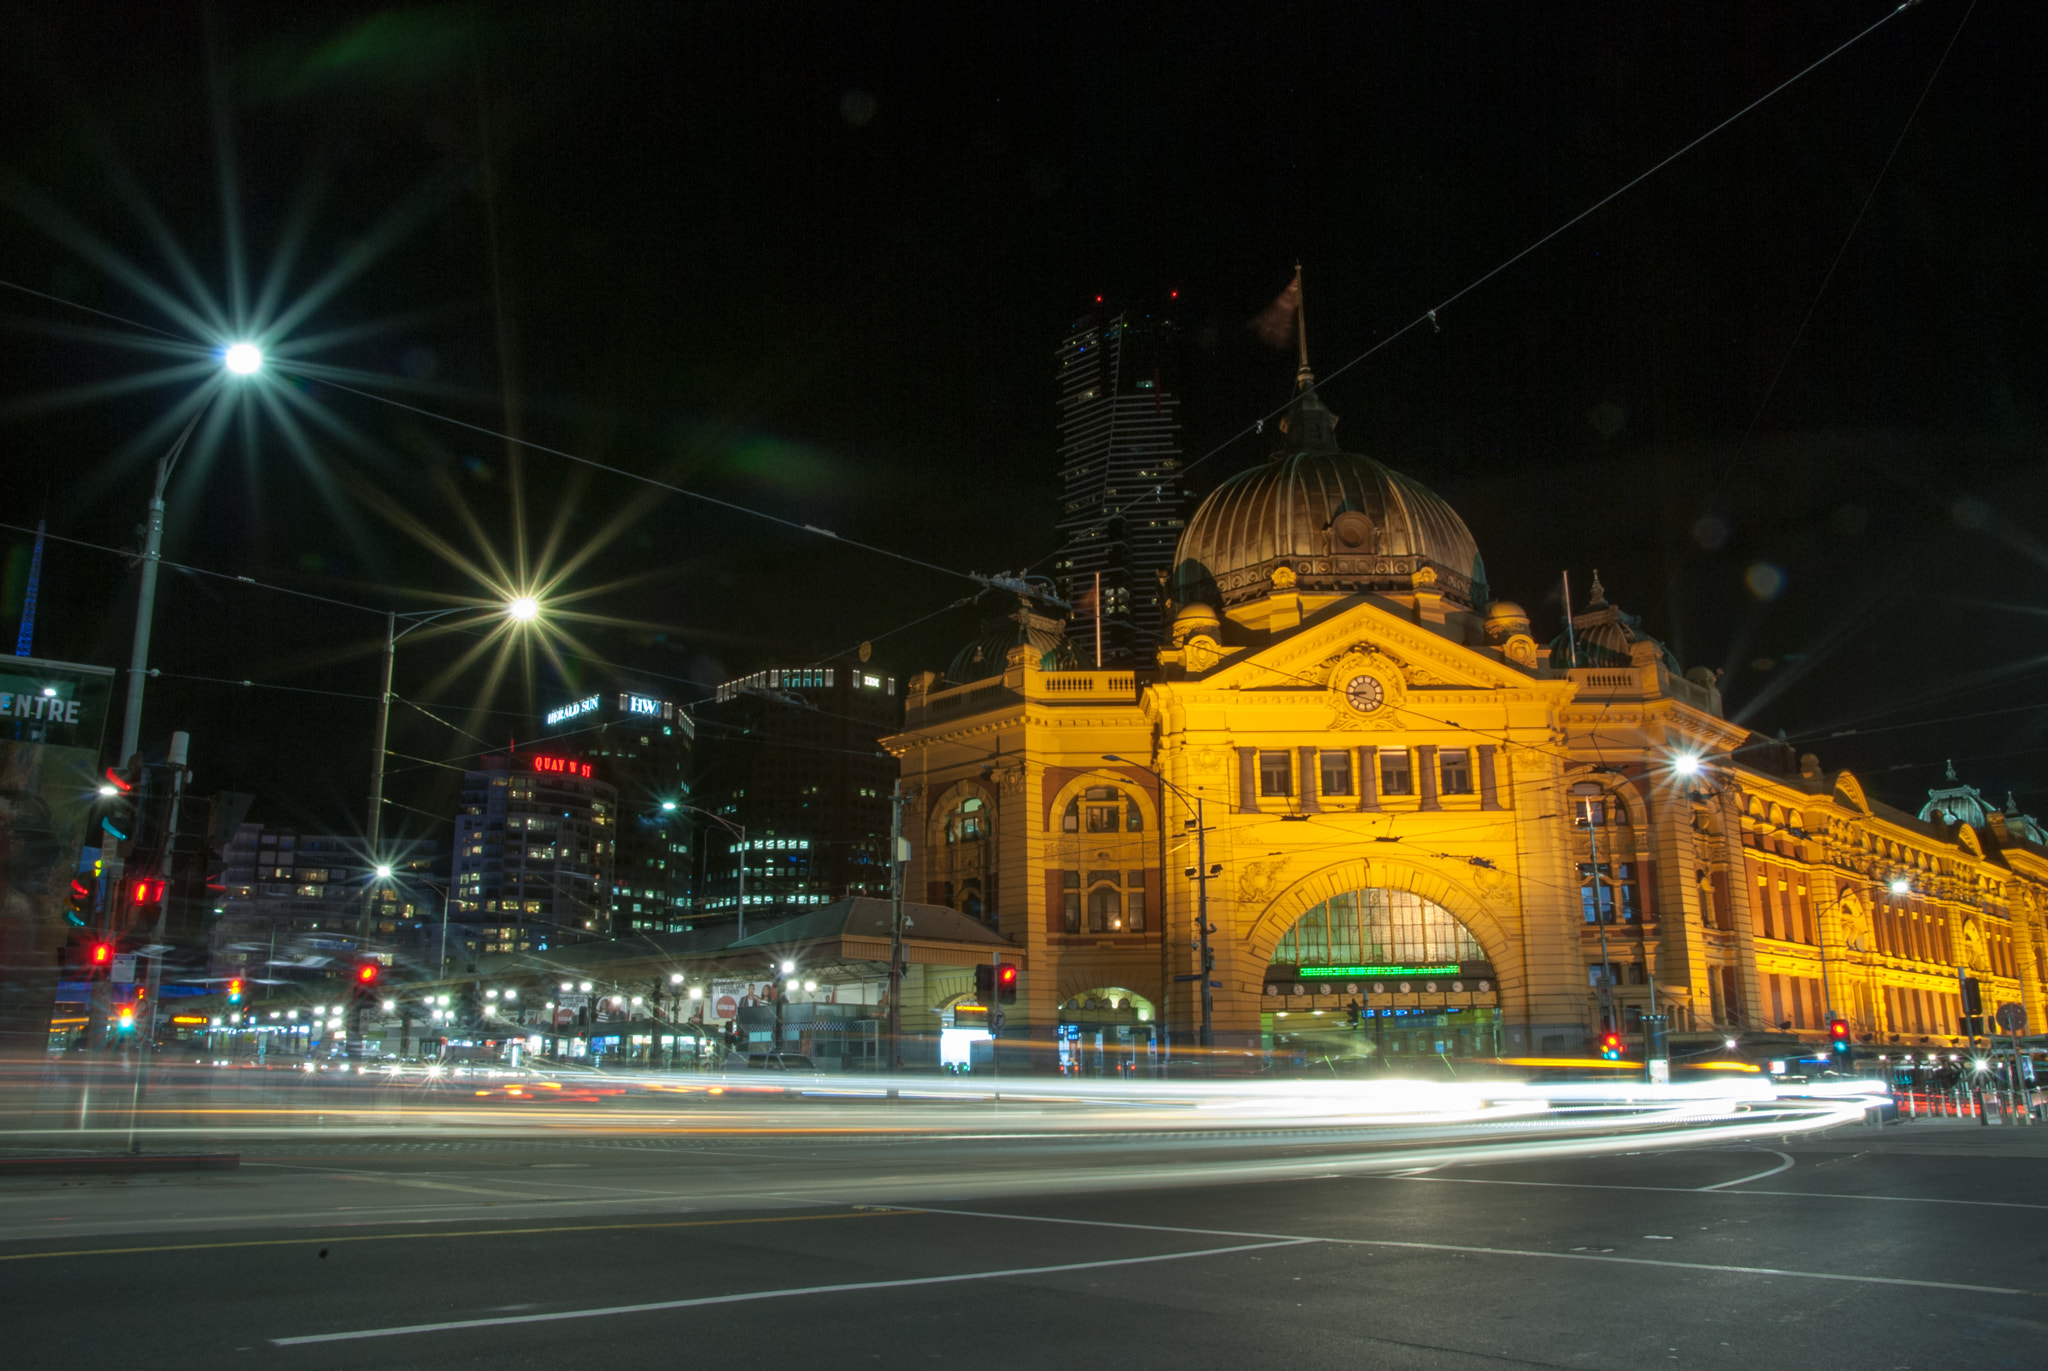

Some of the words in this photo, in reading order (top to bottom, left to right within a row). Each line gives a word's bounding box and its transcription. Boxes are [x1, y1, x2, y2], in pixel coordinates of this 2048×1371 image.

[547, 703, 580, 725] HERALD
[581, 696, 599, 713] SUN
[535, 756, 565, 772] QUAY
